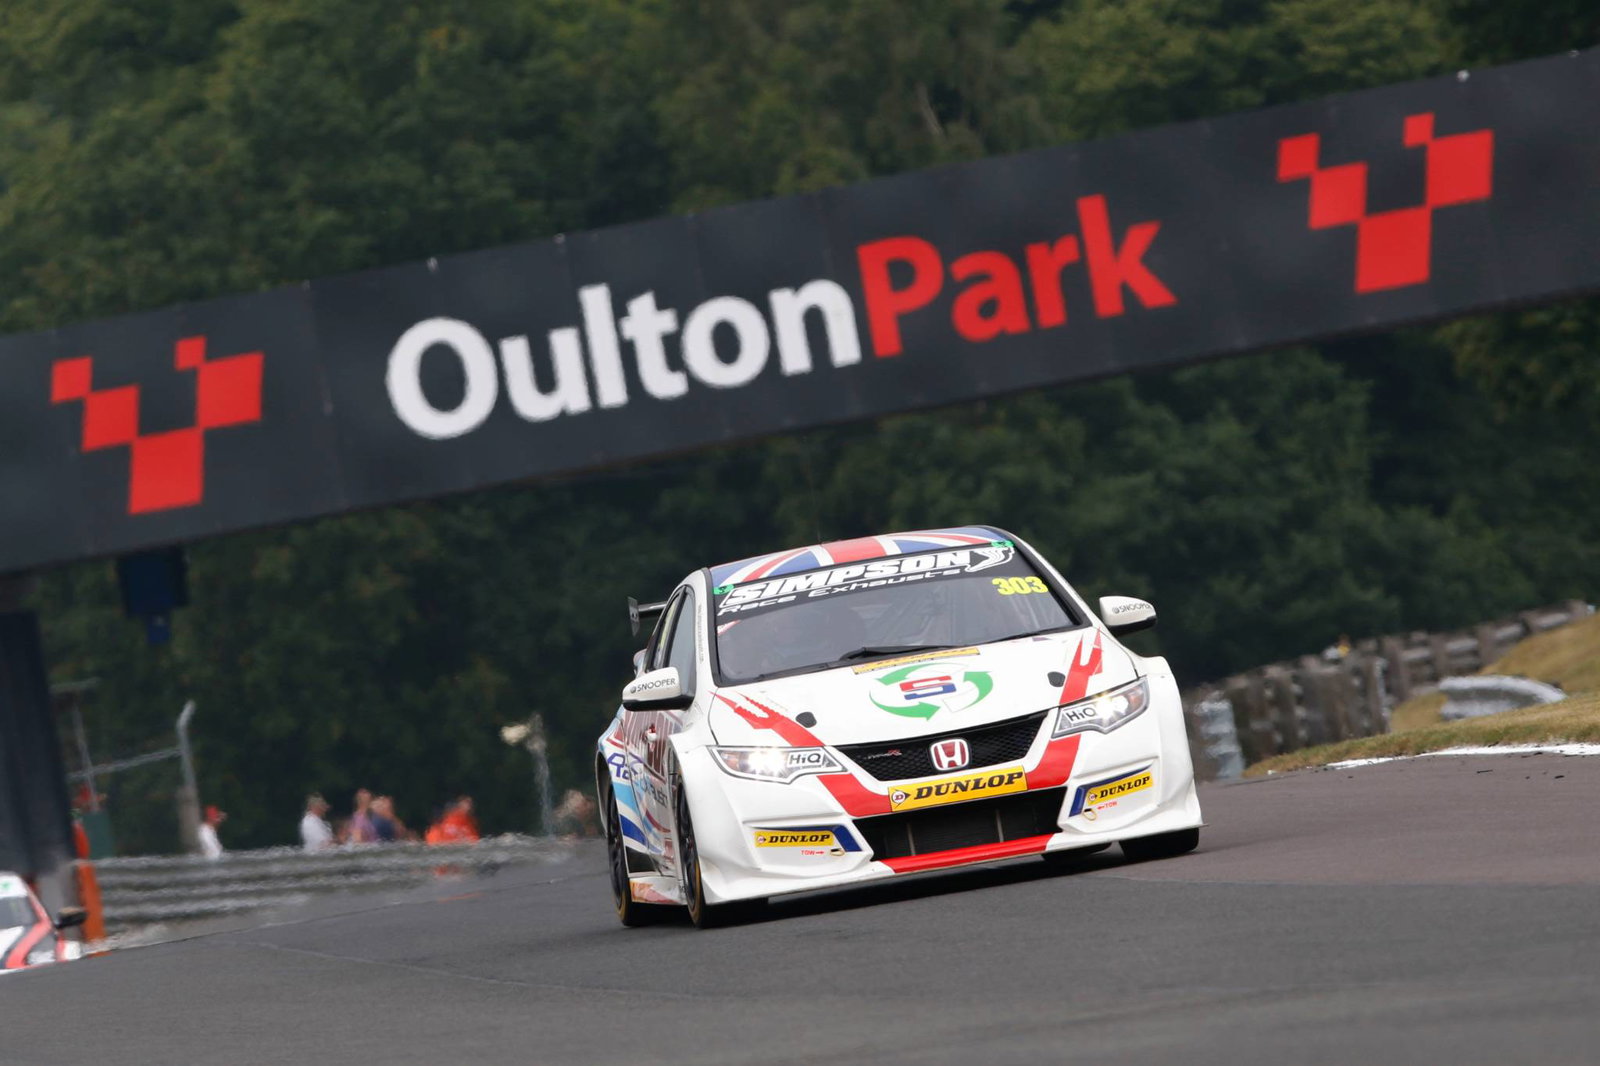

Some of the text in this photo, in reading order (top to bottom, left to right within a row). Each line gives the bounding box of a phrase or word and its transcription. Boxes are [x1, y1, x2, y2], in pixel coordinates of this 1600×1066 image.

[722, 549, 971, 606] SIMPSON
[991, 575, 1049, 596] 303
[717, 568, 961, 616] Race Exhausts
[637, 677, 676, 692] SNOOPER
[789, 752, 821, 765] HiQ
[913, 771, 1024, 800] DUNLOP
[1099, 776, 1150, 799] DUNLOP
[768, 834, 830, 844] DUNLOP
